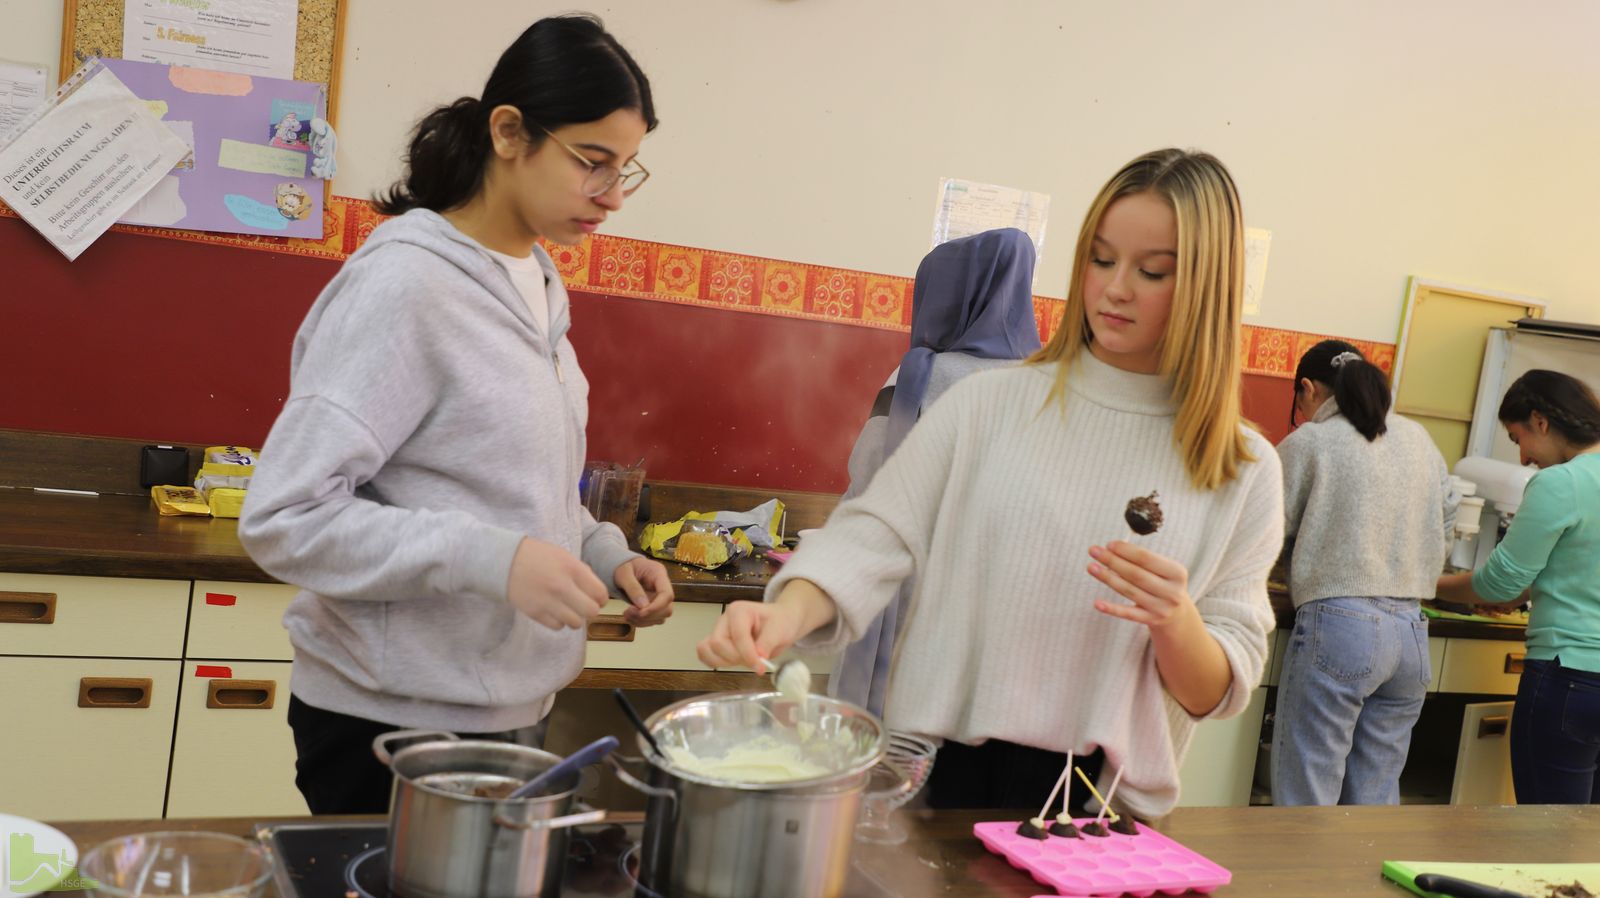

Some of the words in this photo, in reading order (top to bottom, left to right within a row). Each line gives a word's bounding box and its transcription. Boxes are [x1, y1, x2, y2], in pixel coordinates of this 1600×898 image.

[2, 165, 27, 184] Dieses
[25, 155, 37, 166] ist
[34, 147, 47, 158] ein
[11, 122, 92, 192] UNTERRICHTSRAUM
[22, 185, 37, 201] und
[33, 175, 52, 190] kein
[47, 208, 66, 224] Bitte
[63, 196, 81, 211] kein
[78, 172, 106, 198] Geschirr
[58, 190, 105, 232] Arbeitsgruppen
